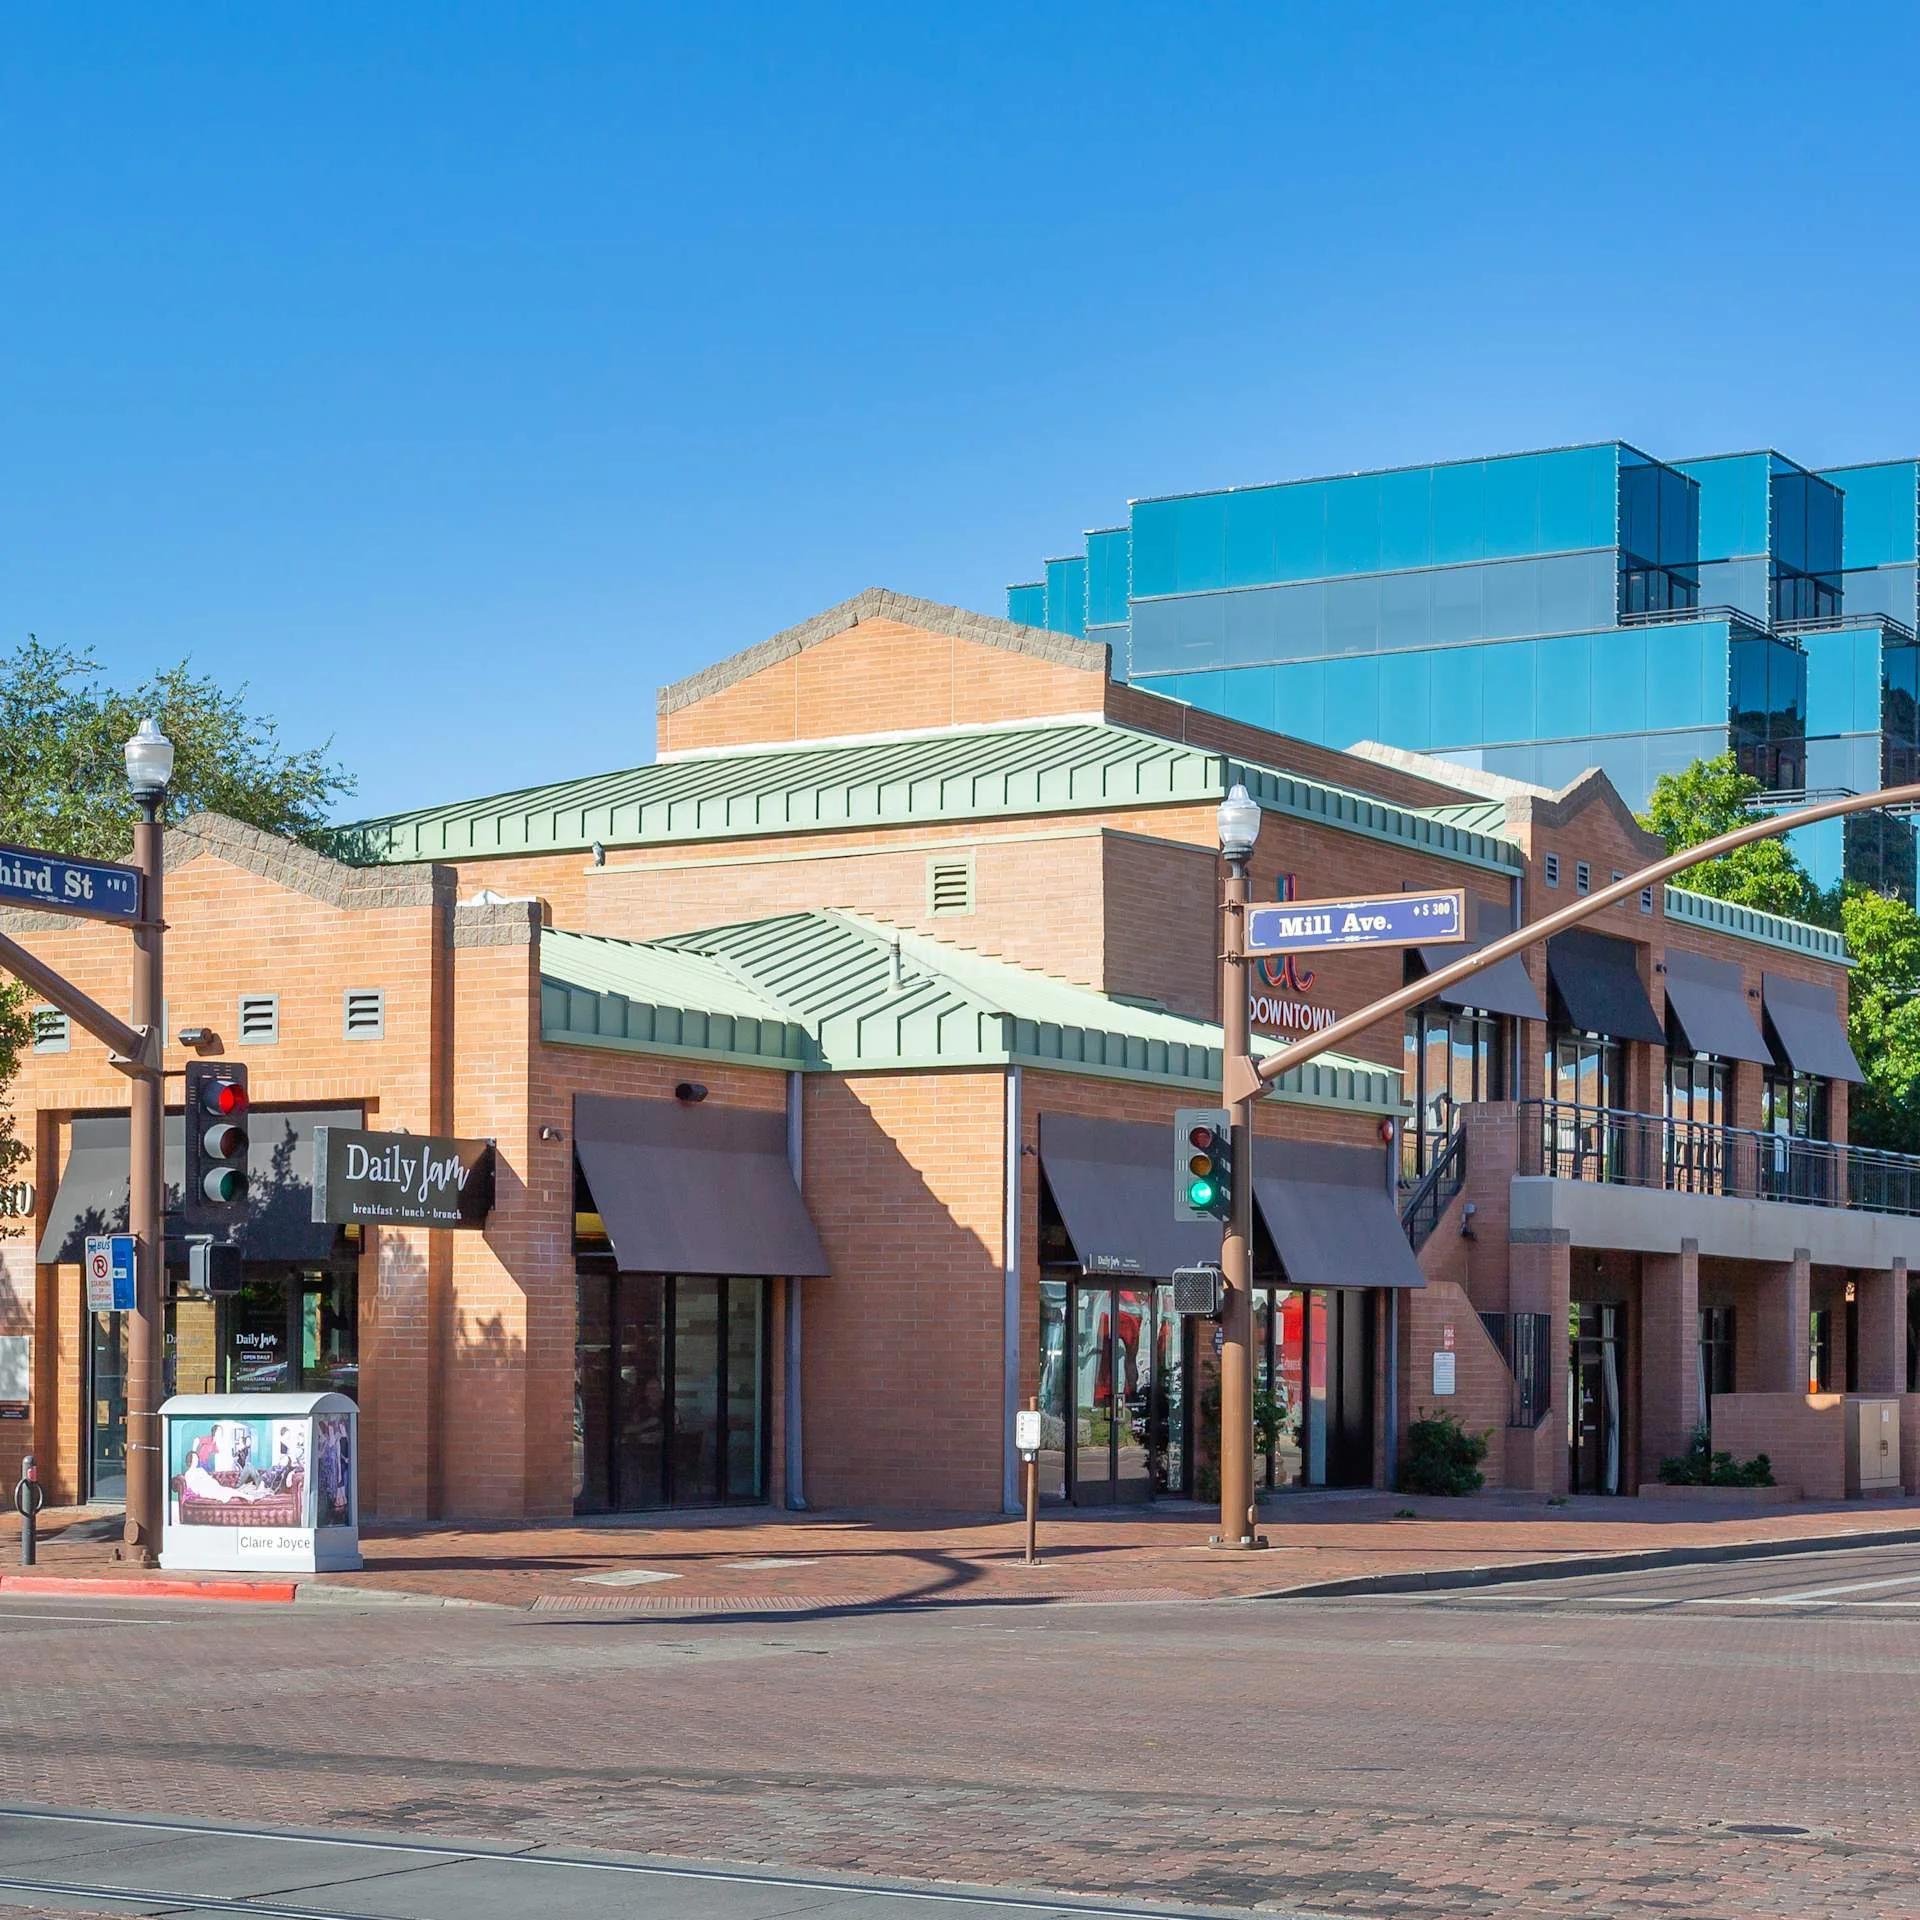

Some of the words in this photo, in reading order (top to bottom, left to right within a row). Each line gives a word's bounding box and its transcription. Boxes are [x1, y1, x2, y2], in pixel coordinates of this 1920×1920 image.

[0, 858, 53, 893] hird
[64, 869, 94, 899] St
[1422, 904, 1430, 916] S
[1432, 902, 1450, 916] 300
[1279, 914, 1332, 937] Mill
[1341, 912, 1393, 933] Ave.
[1249, 996, 1337, 1032] DOWNTOWN
[346, 1144, 417, 1193] Daily
[417, 1145, 470, 1203] Jam
[352, 1203, 393, 1216] breakfast
[401, 1206, 425, 1218] lunch
[433, 1207, 462, 1220] brunch
[97, 1240, 111, 1250] BUS
[236, 1333, 259, 1347] Daily
[240, 1536, 273, 1549] Claire
[277, 1536, 310, 1551] Joyce
